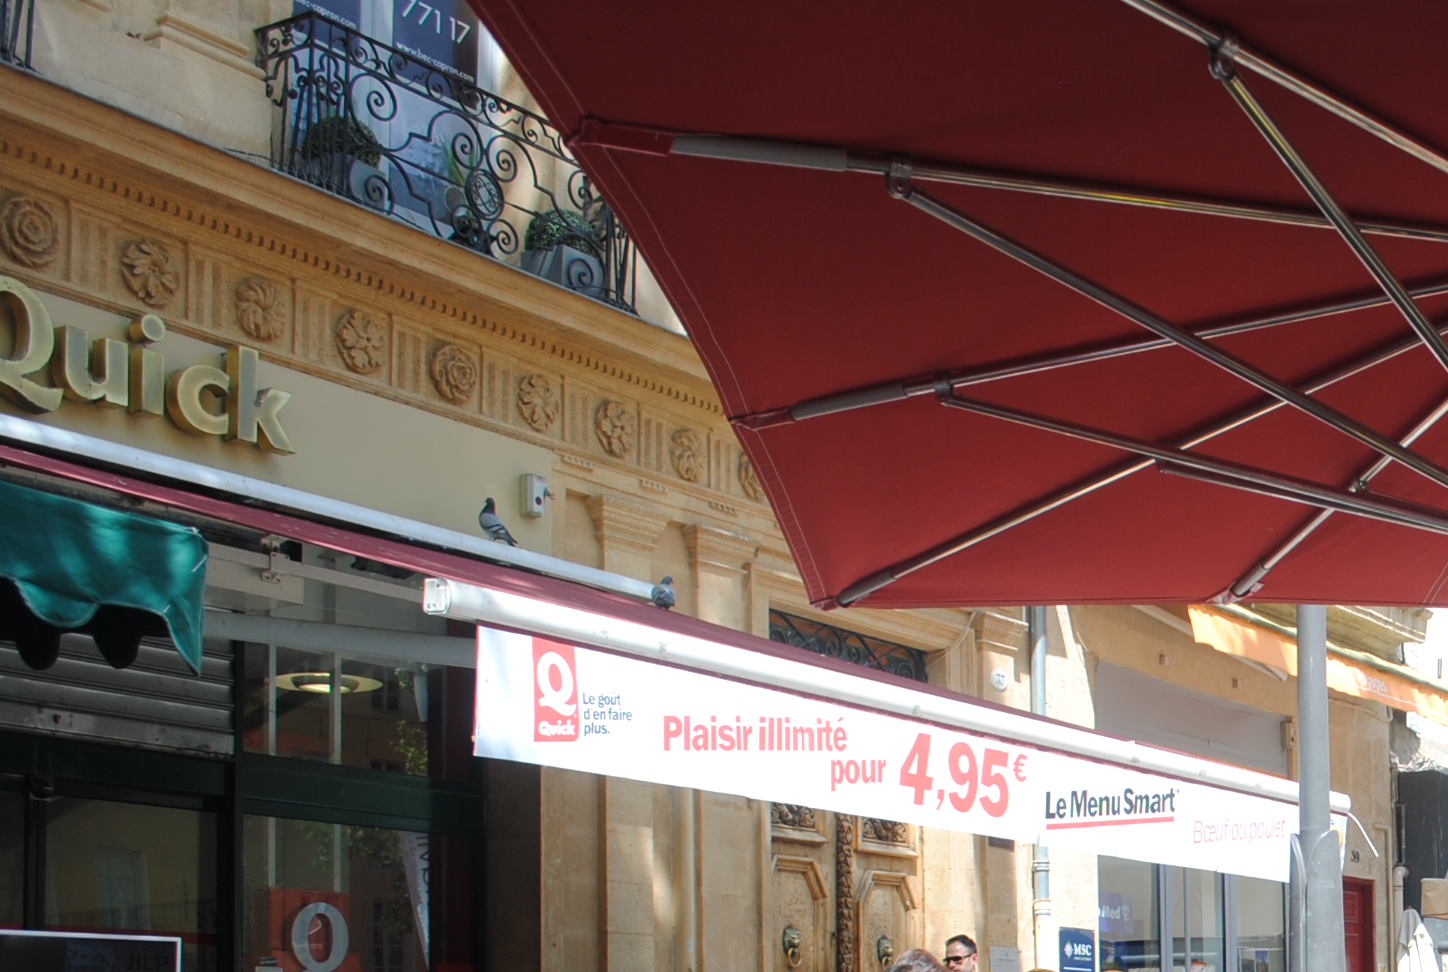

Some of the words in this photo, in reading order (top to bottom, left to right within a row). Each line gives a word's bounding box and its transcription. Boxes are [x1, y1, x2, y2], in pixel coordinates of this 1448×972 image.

[0, 275, 296, 456] Quick
[582, 692, 595, 705] Le
[607, 708, 632, 721] faire
[538, 719, 575, 737] Quick
[584, 722, 610, 736] plus.
[663, 715, 752, 751] Plaisir
[759, 715, 847, 752] illimité
[830, 759, 887, 791] pour
[1045, 791, 1067, 819] Le
[1070, 790, 1121, 817] Menu
[1123, 788, 1176, 815] Smart
[1231, 823, 1247, 841] ou
[1248, 816, 1286, 845] poulet
[1350, 850, 1360, 863] 39
[1101, 905, 1120, 920] Med
[1073, 943, 1092, 956] MSC
